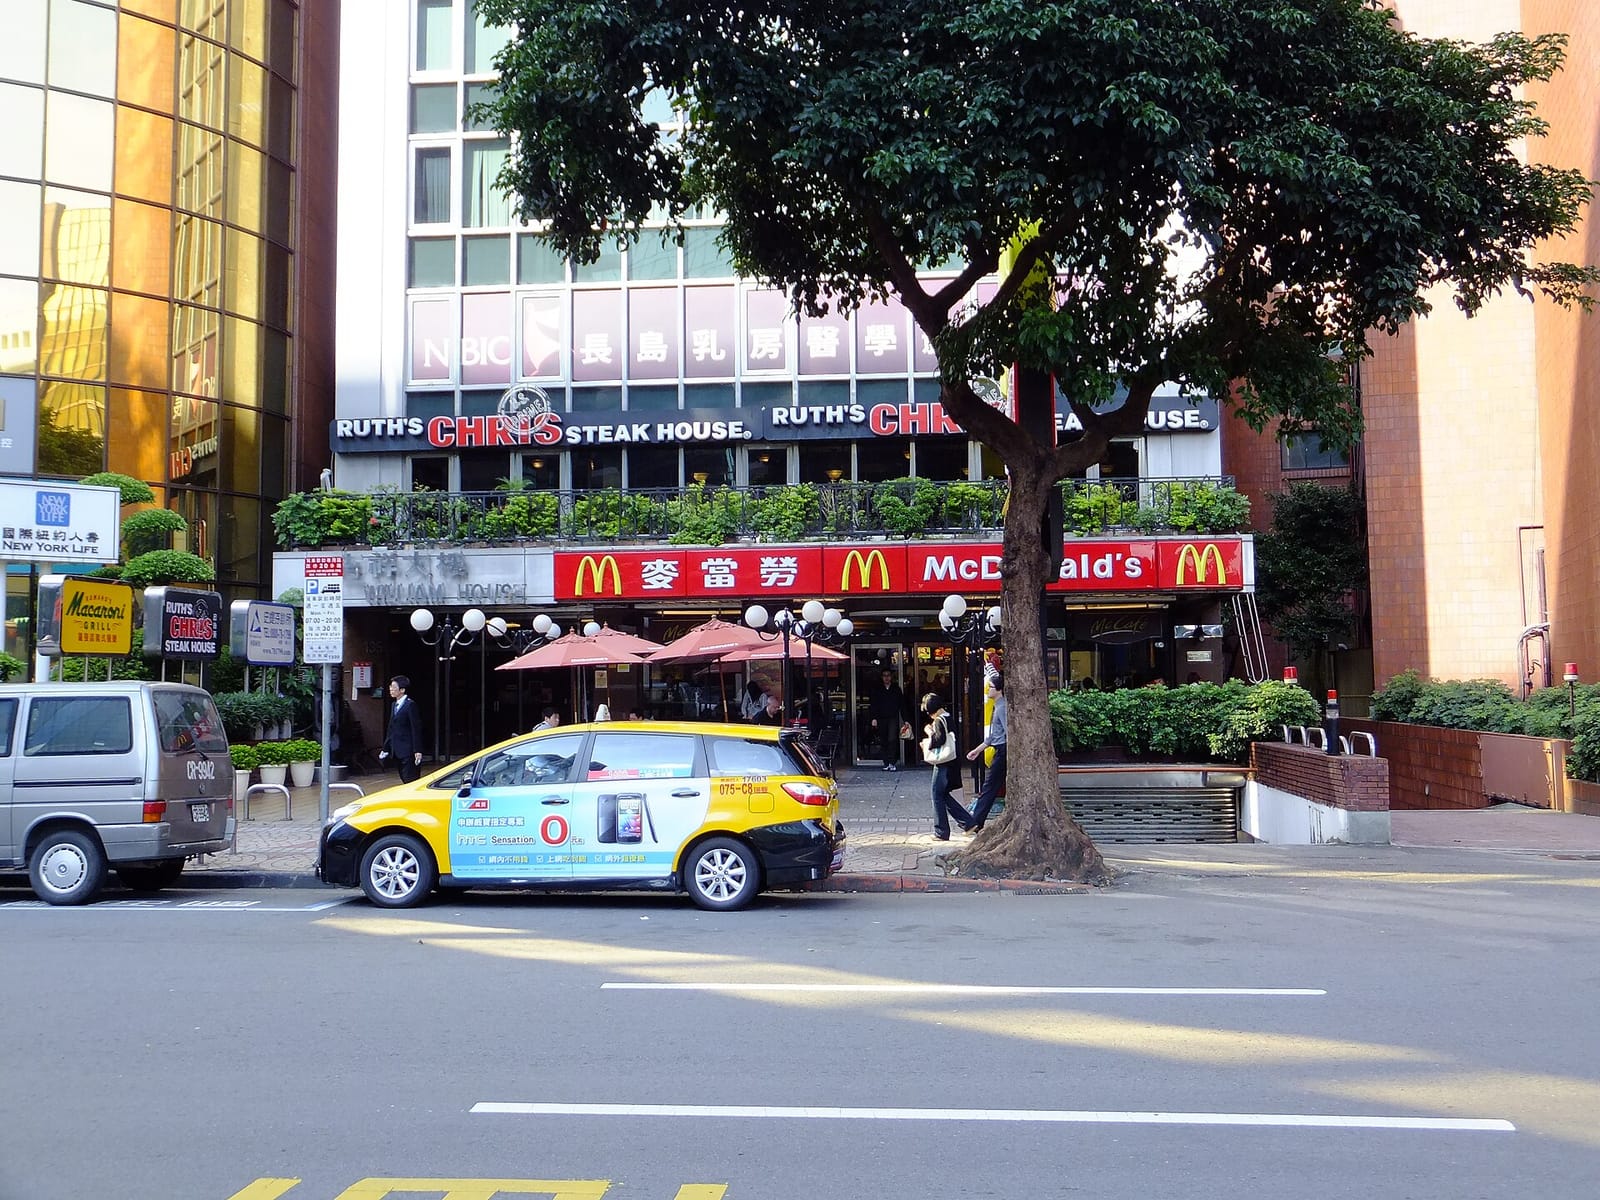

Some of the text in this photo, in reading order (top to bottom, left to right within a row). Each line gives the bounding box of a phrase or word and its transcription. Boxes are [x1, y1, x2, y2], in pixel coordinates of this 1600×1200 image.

[578, 323, 937, 365] 長島乳房醫學
[772, 404, 866, 425] RUTH'S
[869, 402, 967, 436] CHR
[336, 417, 424, 438] RUTH'S
[427, 414, 563, 448] CHRIS
[565, 423, 650, 444] STEAK
[41, 495, 66, 505] NEW
[38, 503, 68, 514] YORK
[41, 512, 65, 522] LIFE
[3, 541, 99, 554] NEW YORK LIFE
[641, 556, 798, 590] 麥當勞
[923, 553, 1143, 581] McDald's
[307, 580, 318, 594] P
[65, 591, 127, 619] Macaroni
[166, 601, 193, 615] RUTH'S
[83, 621, 111, 631] GRILL
[170, 615, 213, 640] CHRIS
[165, 640, 217, 653] STEAK HOUSE
[719, 783, 753, 796] 075-C8
[456, 834, 487, 845] htc
[491, 836, 535, 845] Sensation
[540, 815, 568, 845] 0
